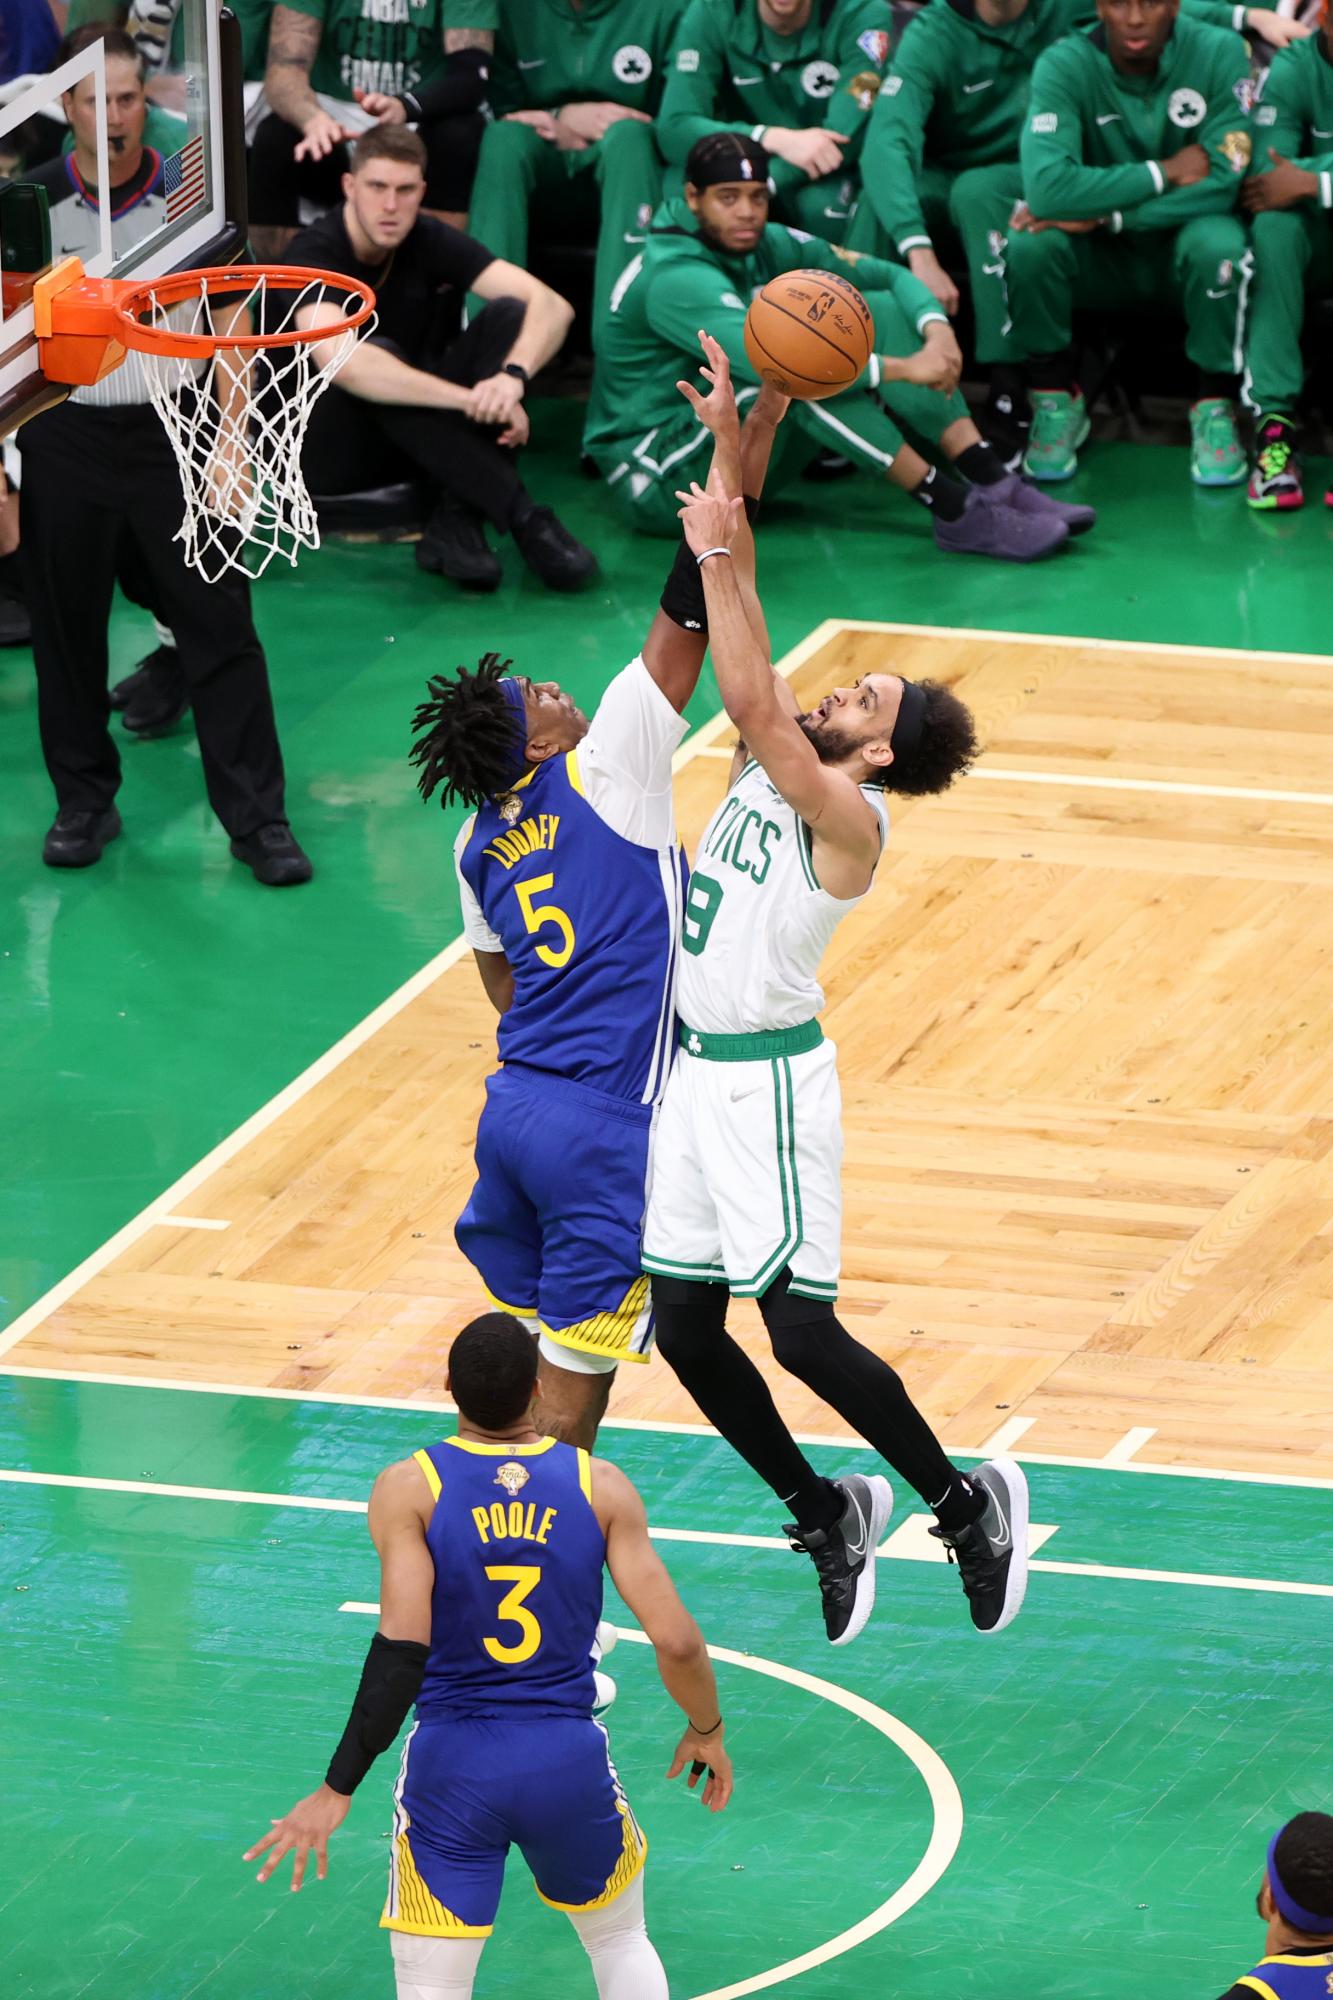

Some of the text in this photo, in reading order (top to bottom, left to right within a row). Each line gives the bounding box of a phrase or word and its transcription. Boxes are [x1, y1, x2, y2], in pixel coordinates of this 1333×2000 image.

[482, 814, 560, 870] LOONEY
[514, 872, 575, 968] 5
[682, 870, 724, 957] 9
[471, 1501, 557, 1544] POOLE
[482, 1565, 541, 1664] 3
